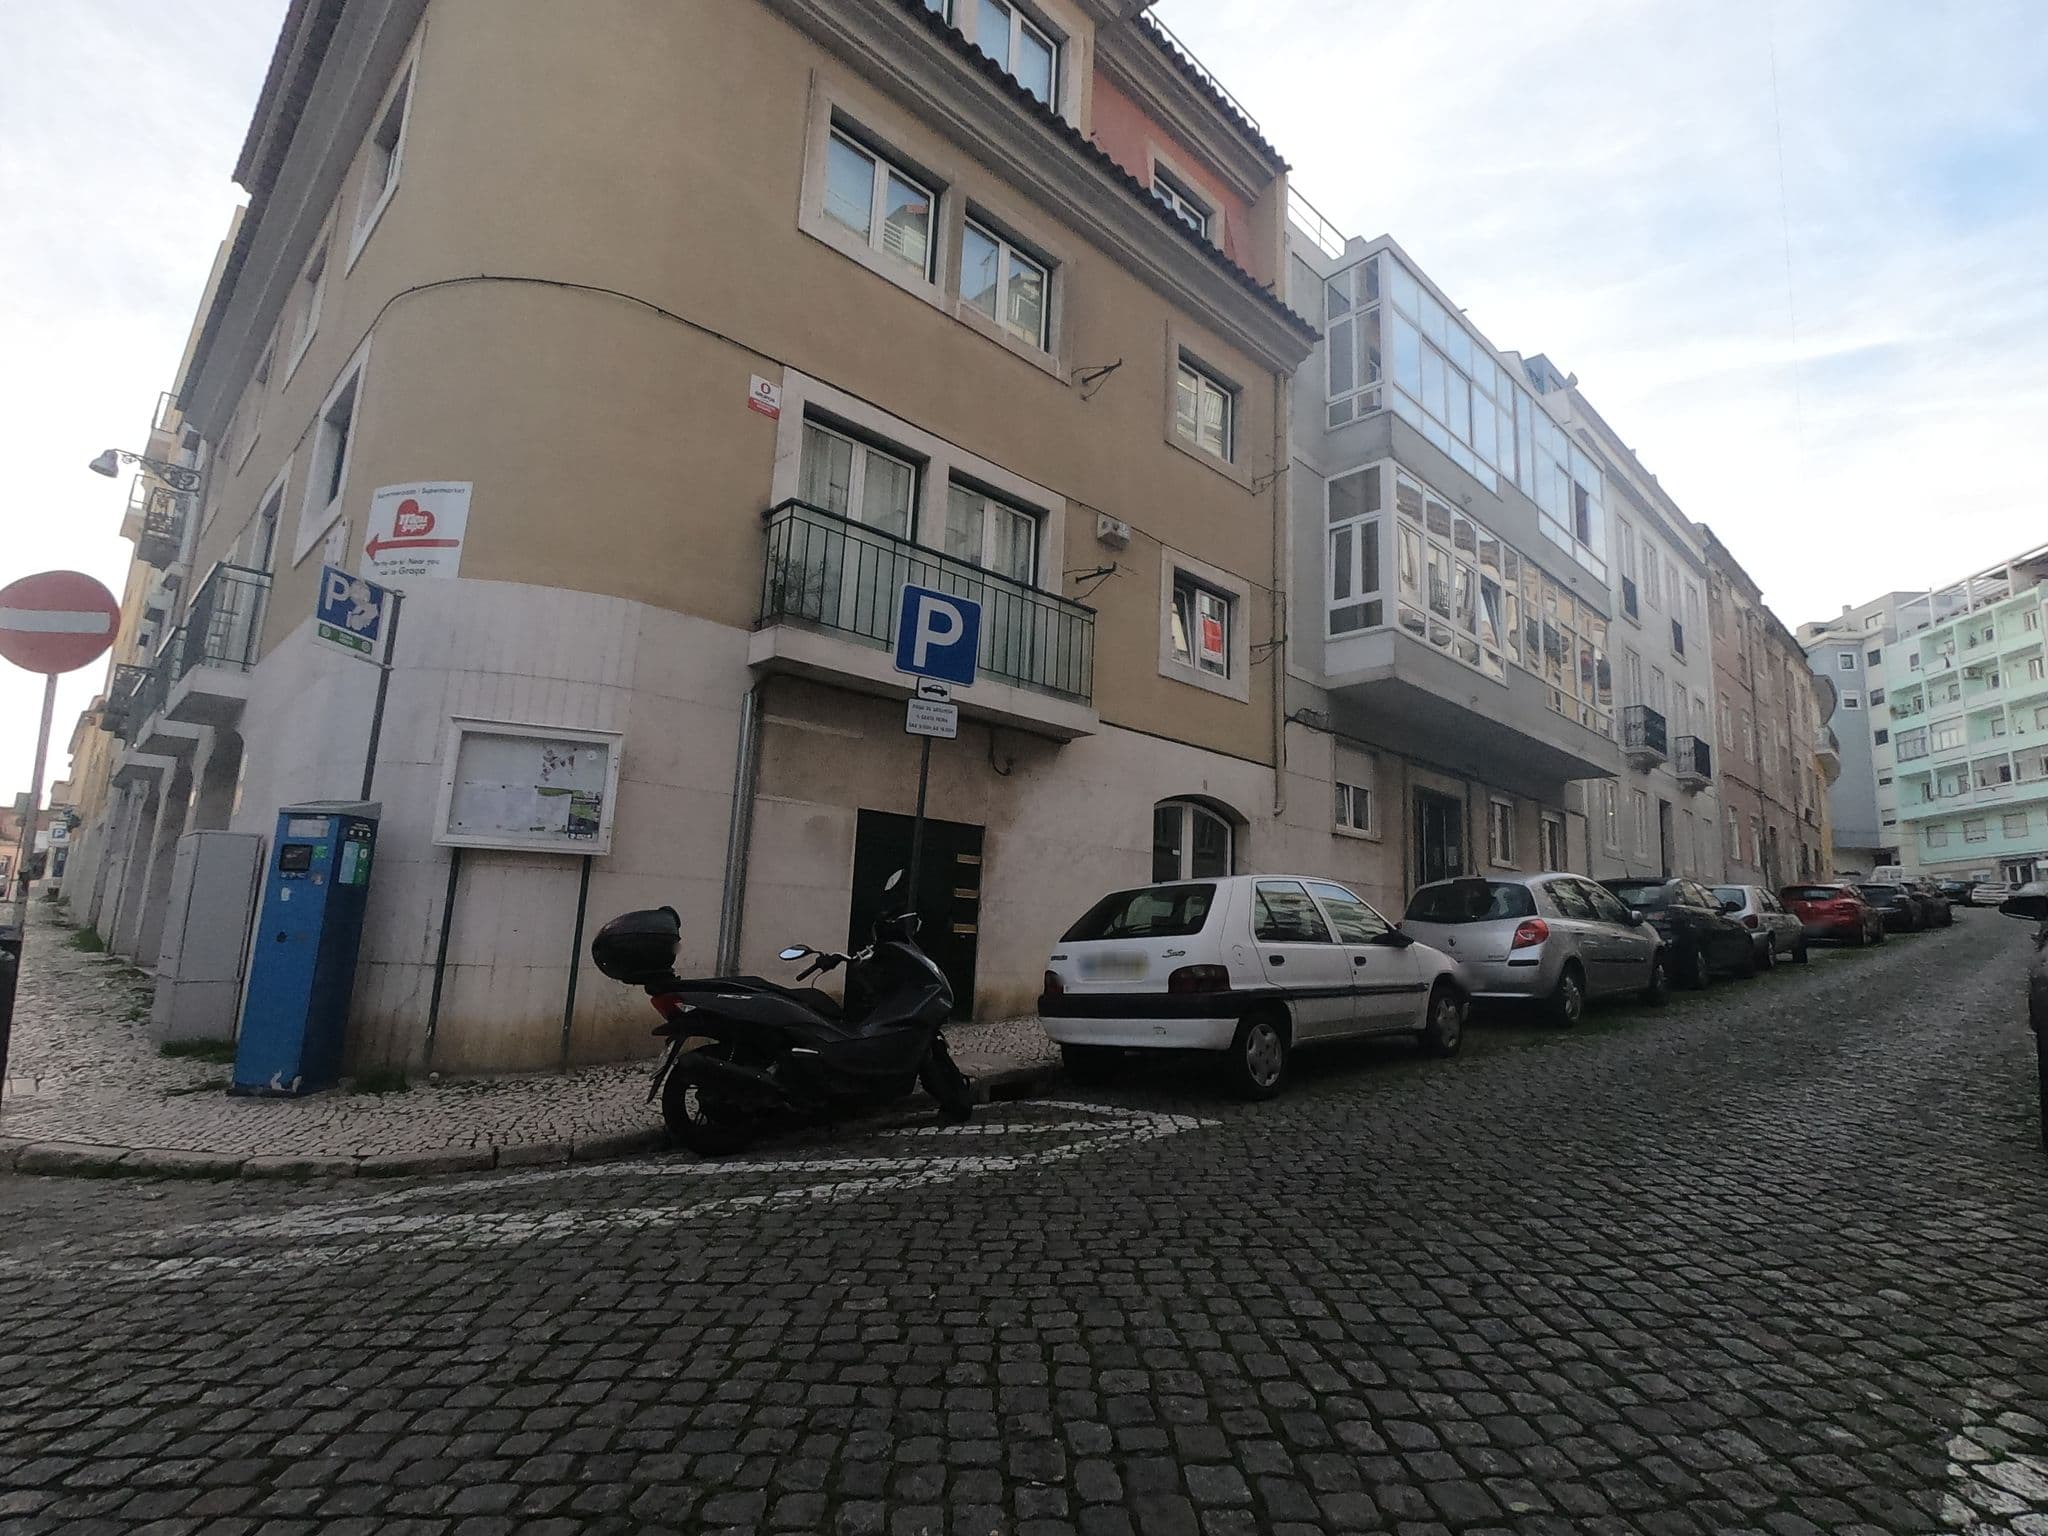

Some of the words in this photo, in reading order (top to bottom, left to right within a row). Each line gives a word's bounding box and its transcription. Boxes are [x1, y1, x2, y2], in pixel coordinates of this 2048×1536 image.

[399, 566, 426, 577] Graça
[325, 572, 350, 610] P
[913, 595, 964, 668] P
